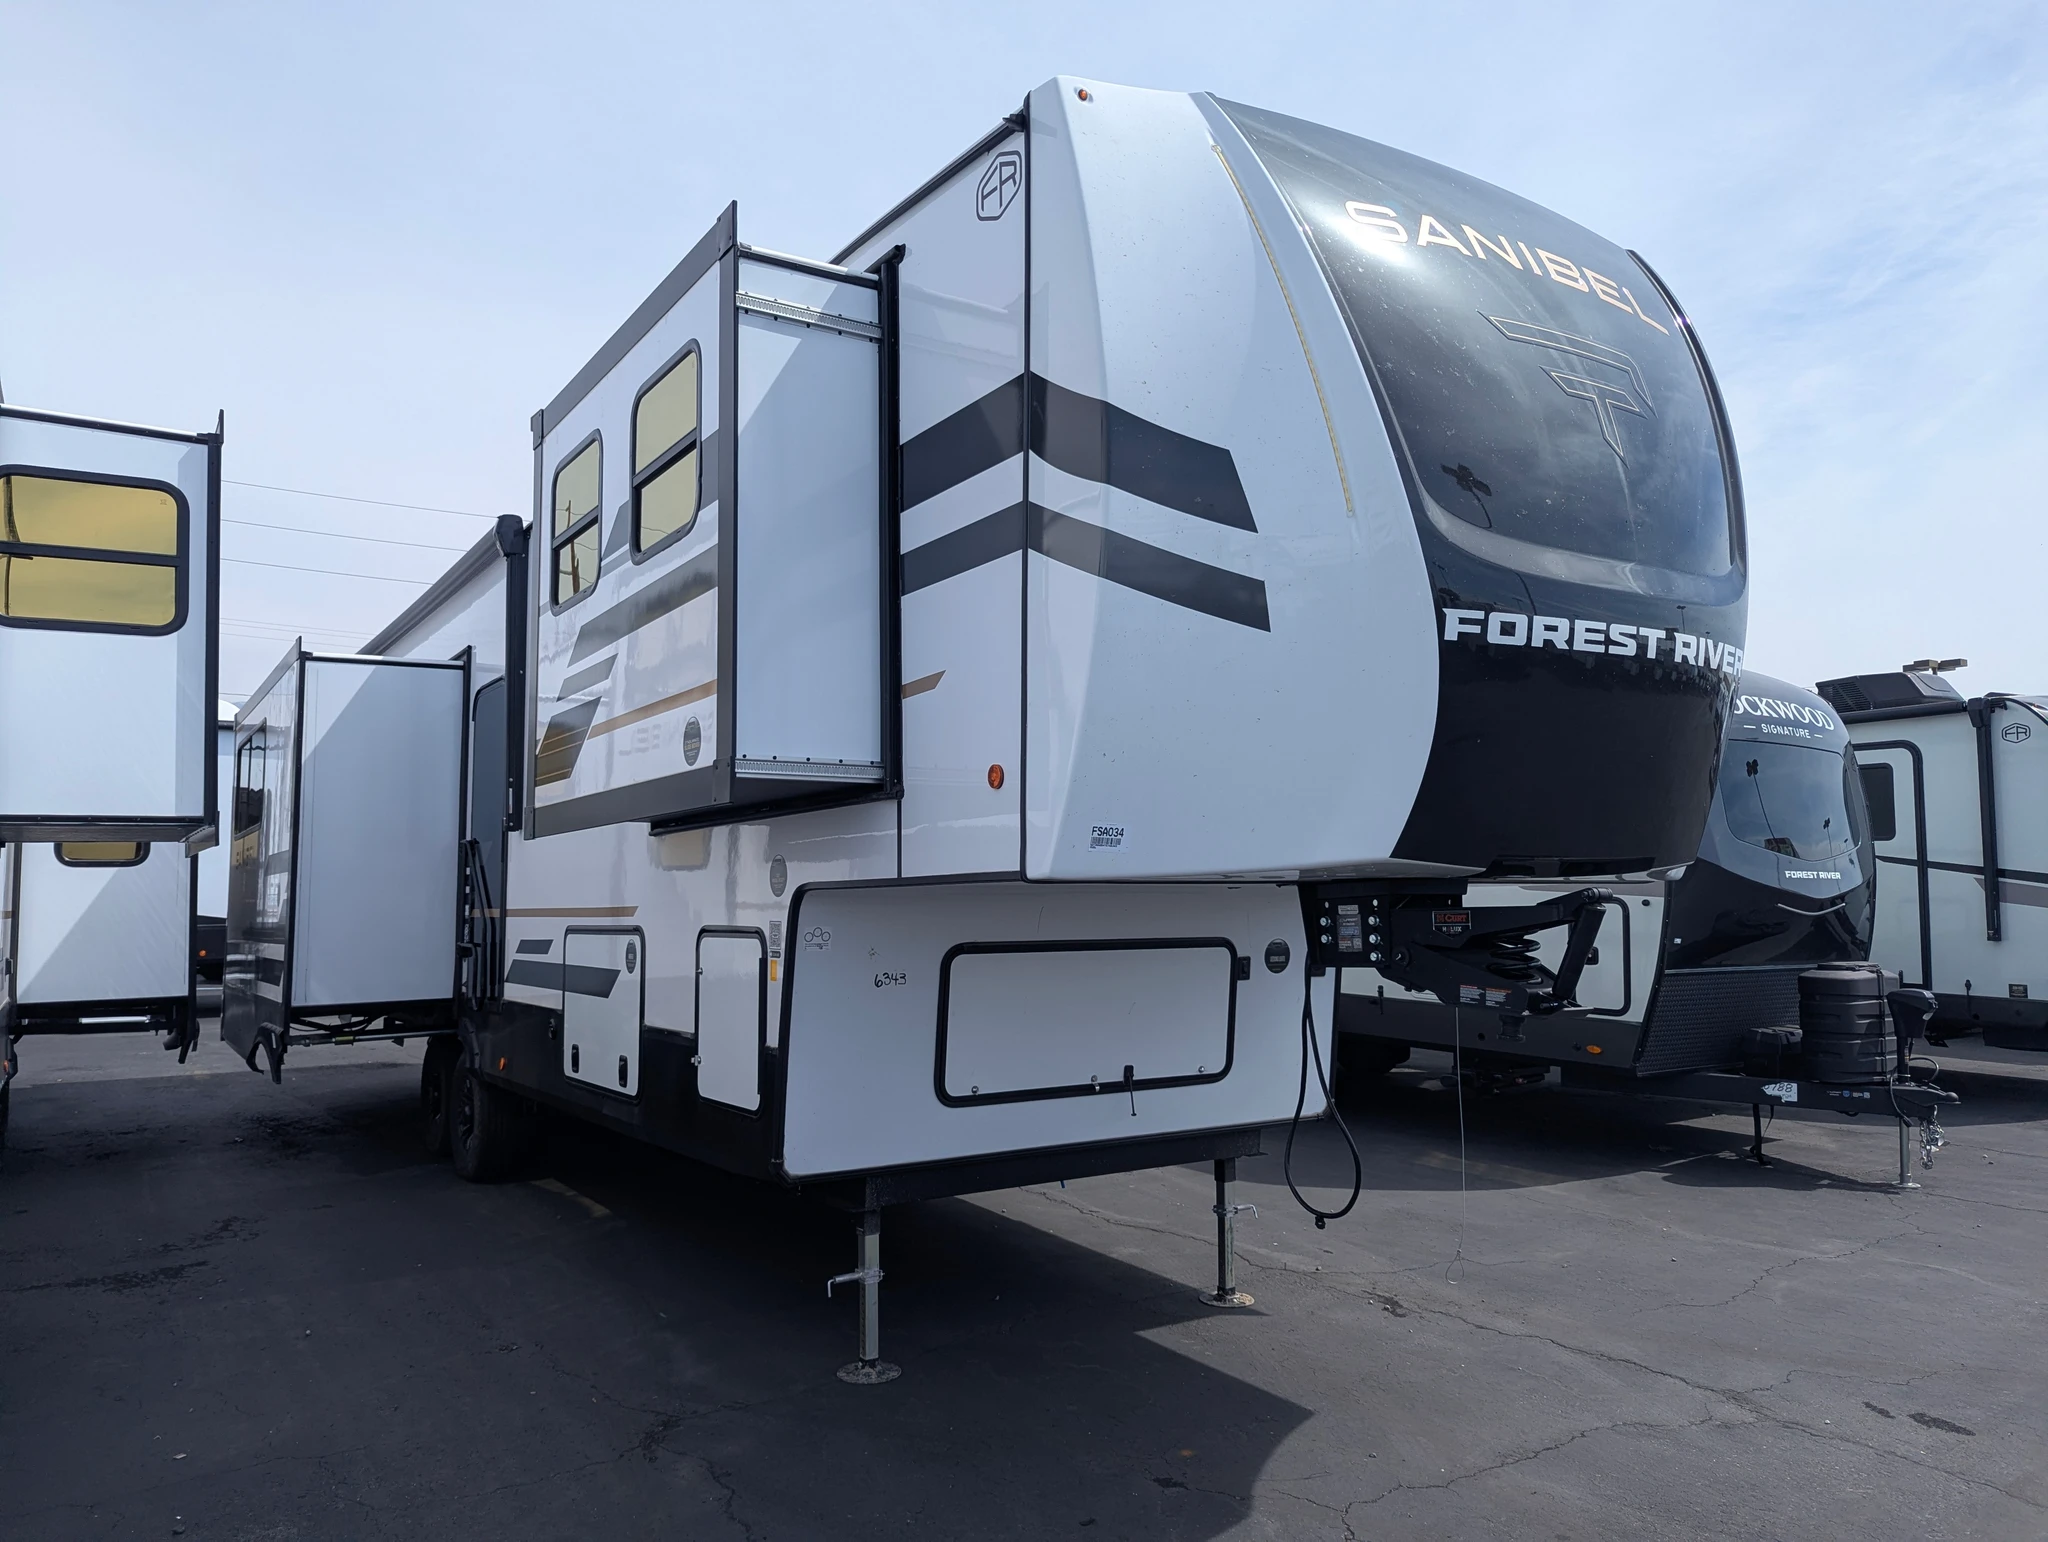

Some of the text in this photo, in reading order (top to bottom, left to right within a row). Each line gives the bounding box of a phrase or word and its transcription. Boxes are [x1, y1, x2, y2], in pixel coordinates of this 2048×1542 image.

[1343, 199, 1670, 336] SANIBEL
[1441, 607, 1744, 678] FOREST RIVER
[1761, 723, 1812, 739] SIGNATURE
[1091, 825, 1125, 838] FSA034
[1784, 870, 1842, 880] FOREST RIVER
[874, 971, 907, 988] 6343
